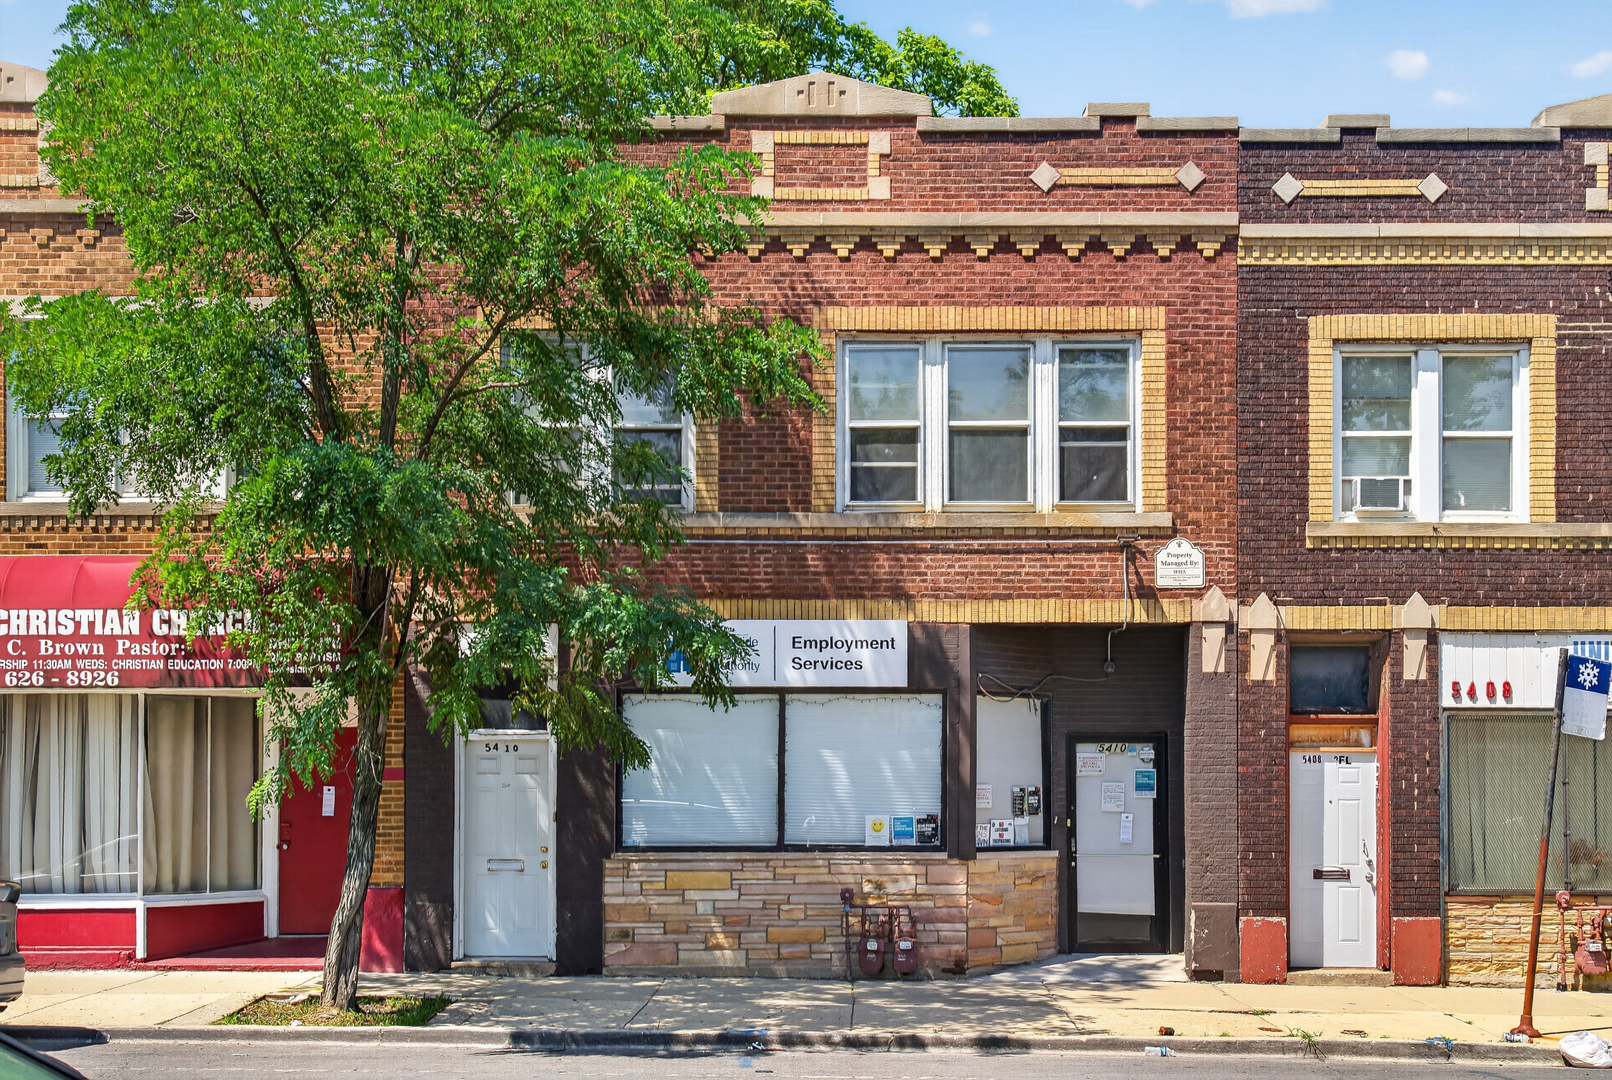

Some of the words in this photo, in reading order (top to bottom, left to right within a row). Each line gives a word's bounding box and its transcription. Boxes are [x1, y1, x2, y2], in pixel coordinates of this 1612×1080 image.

[7, 638, 27, 656] C.
[38, 638, 105, 656] Brown
[115, 638, 186, 656] Pastor:
[791, 635, 896, 653] Employment
[33, 659, 72, 670] 11:30AM
[76, 659, 108, 670] WEDS:
[112, 659, 164, 670] CHRISTIAN
[167, 659, 224, 670] EDUCATION
[791, 656, 864, 671] Services
[4, 670, 45, 687] 626
[66, 670, 120, 687] 8926
[1451, 680, 1512, 699] 5408
[1098, 743, 1127, 753] 5410
[1302, 754, 1322, 764] 5408
